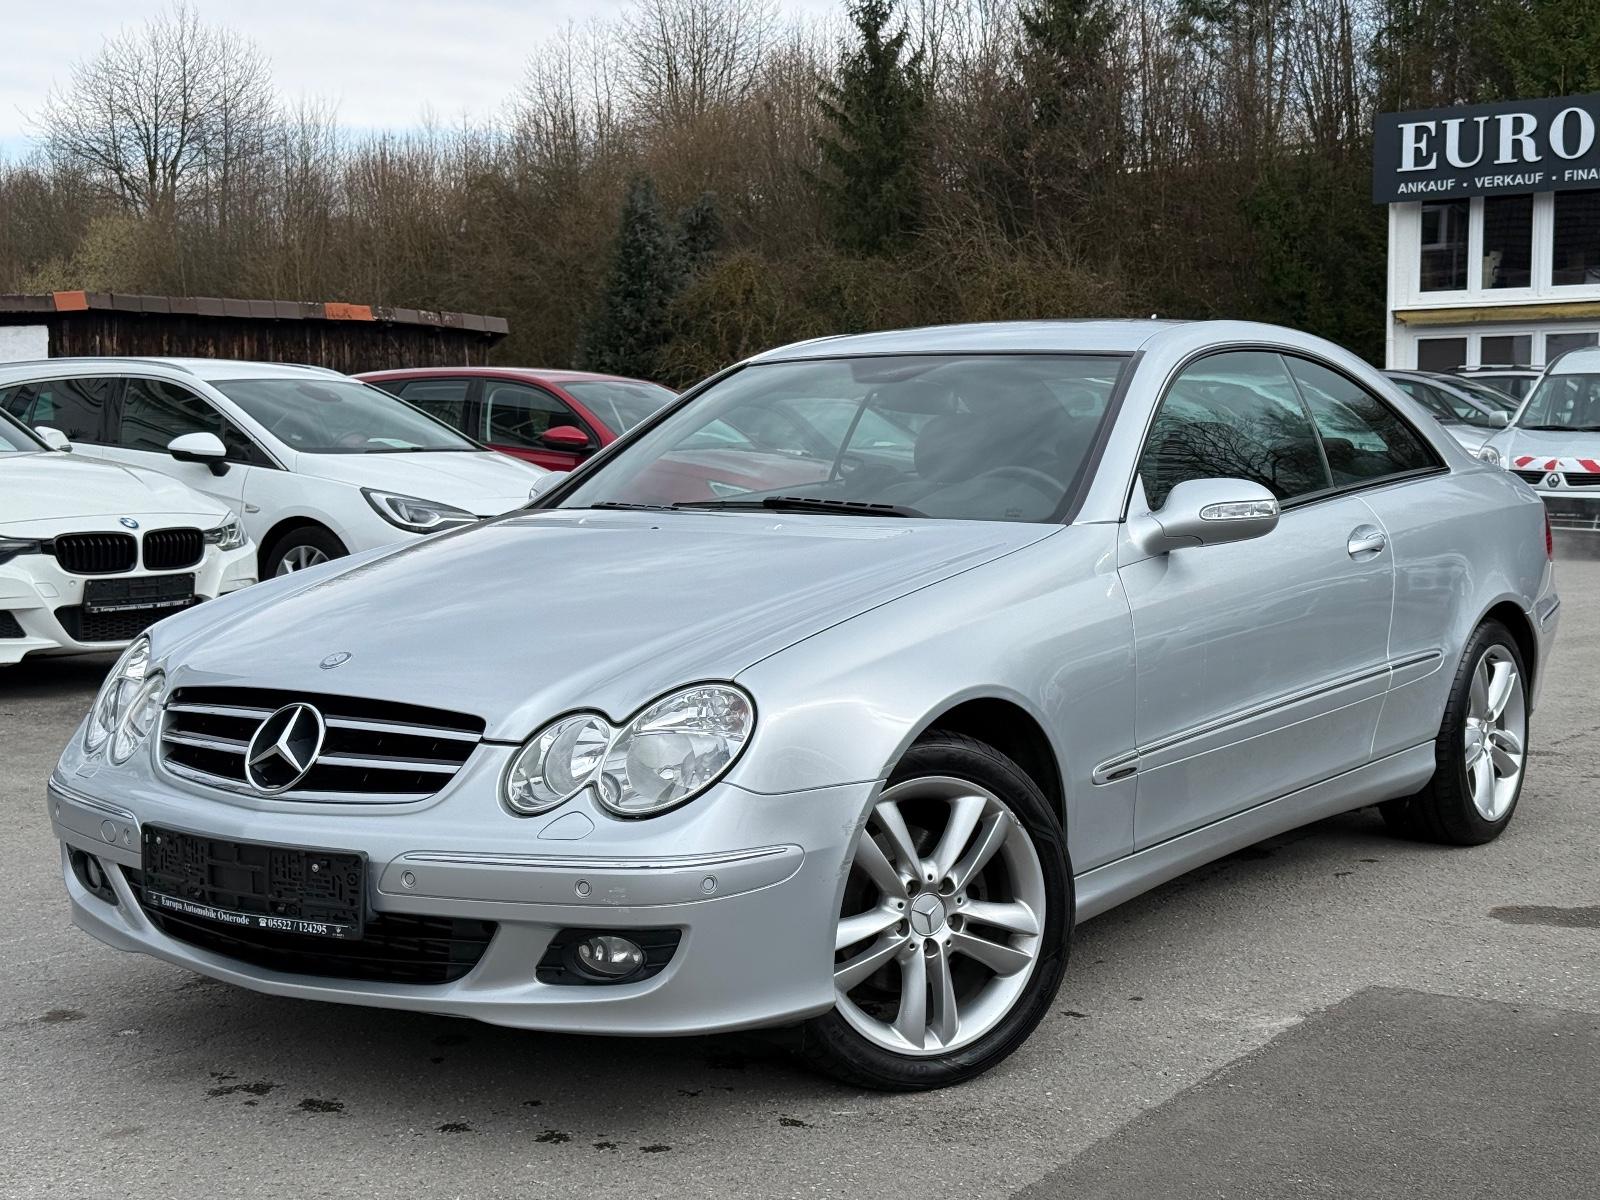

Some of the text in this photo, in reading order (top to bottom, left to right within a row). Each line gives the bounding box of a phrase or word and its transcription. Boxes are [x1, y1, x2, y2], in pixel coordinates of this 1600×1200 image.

[1396, 107, 1595, 172] EURO
[1397, 167, 1600, 194] ANKAUF VERKAUF FINA
[161, 896, 182, 911] Europa
[183, 902, 217, 919] Automobile
[217, 911, 250, 925] Osterode
[267, 918, 291, 930] 05522
[299, 922, 327, 935] 124295
